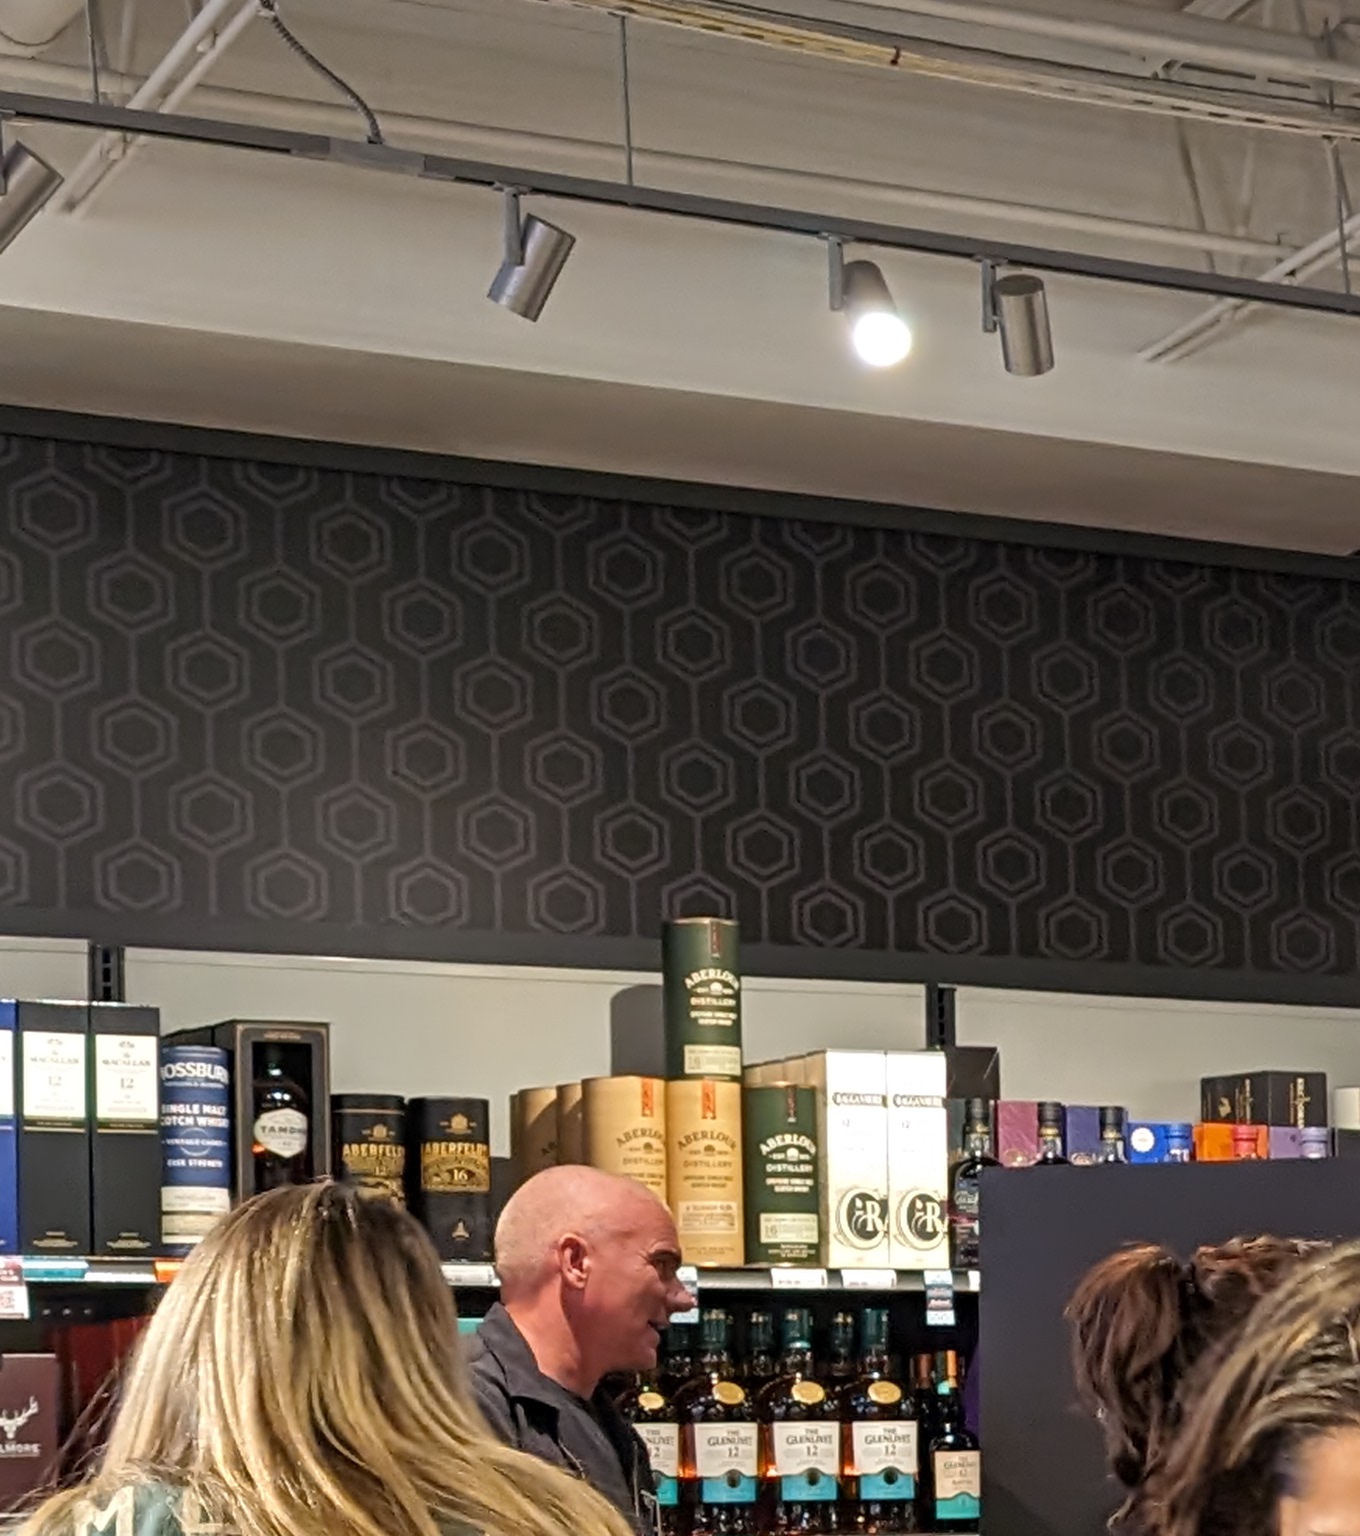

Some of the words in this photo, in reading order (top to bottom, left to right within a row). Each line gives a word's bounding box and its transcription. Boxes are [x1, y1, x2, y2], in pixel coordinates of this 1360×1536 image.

[452, 1168, 469, 1182] 16
[728, 1446, 740, 1459] 12
[806, 1445, 818, 1457] 12
[884, 1444, 897, 1457] 12
